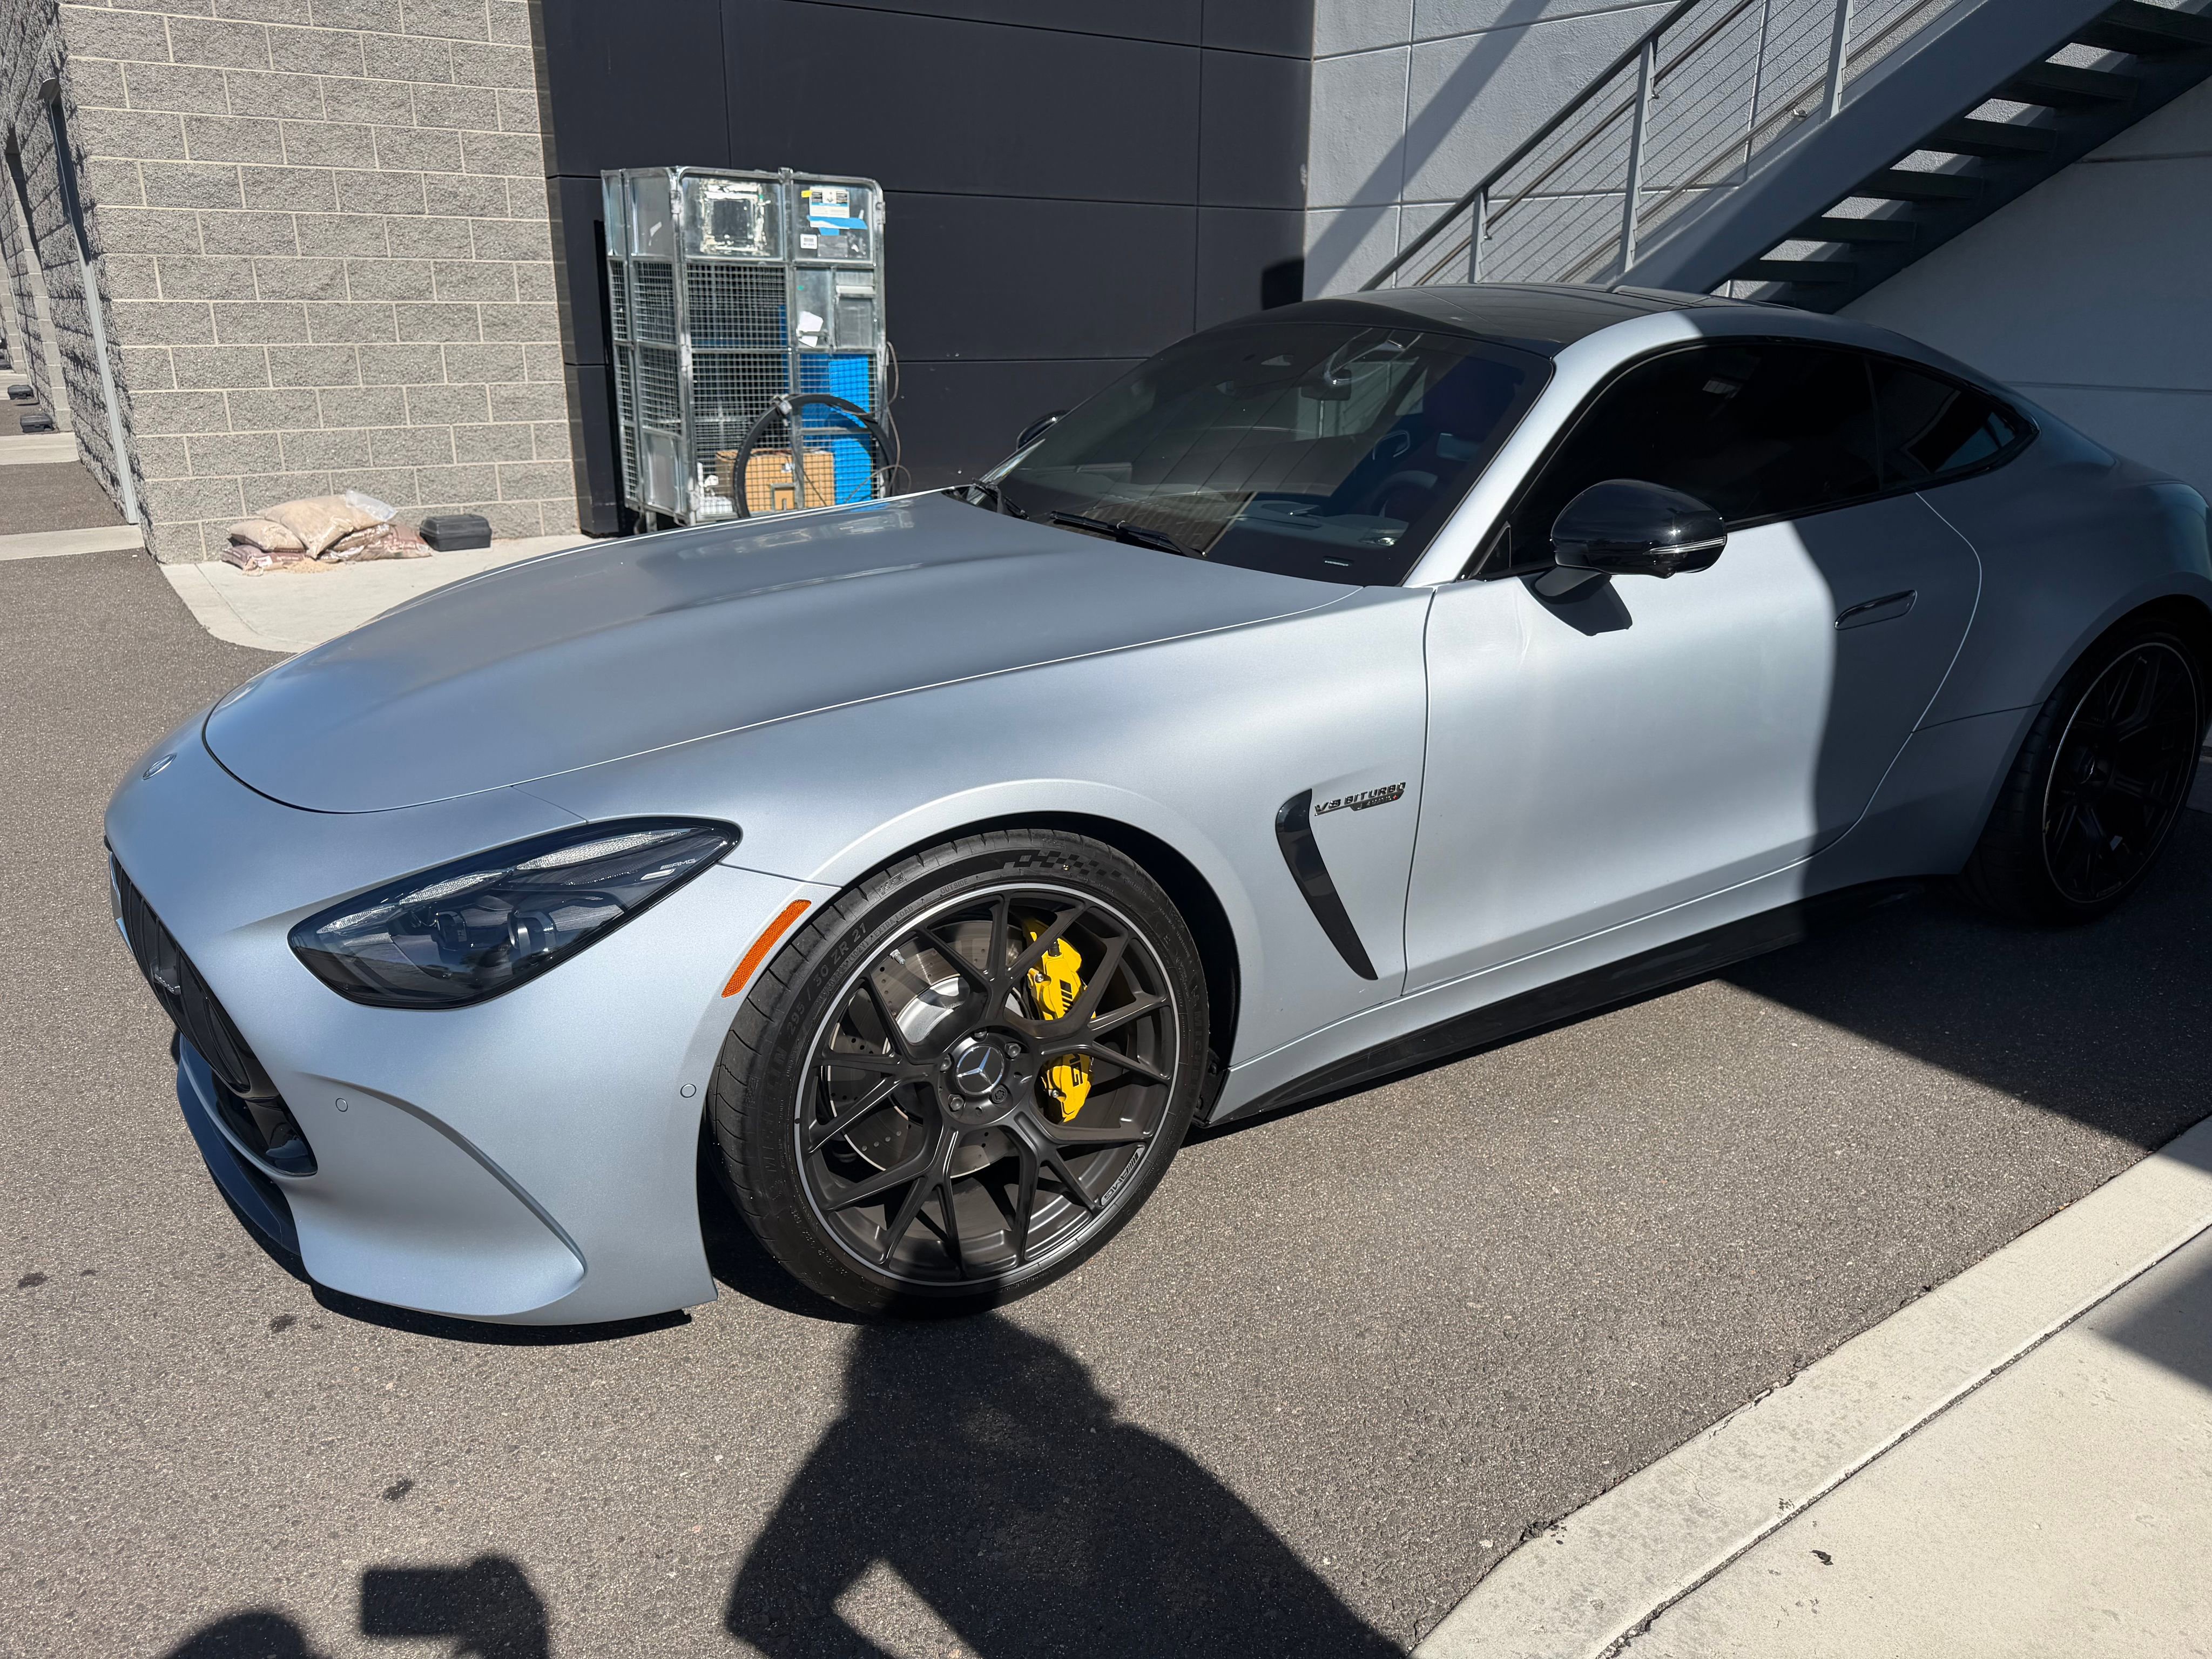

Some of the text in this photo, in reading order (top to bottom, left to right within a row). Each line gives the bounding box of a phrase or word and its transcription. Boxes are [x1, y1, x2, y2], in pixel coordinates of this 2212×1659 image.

[1314, 799, 1341, 812] V8
[1344, 782, 1406, 805] BITURBO
[940, 878, 968, 894] OUTSIDE
[873, 905, 914, 937] EXTRA LOAD
[787, 1003, 805, 1035] 295
[831, 940, 849, 965] ZR
[851, 922, 867, 942] 21
[1104, 1166, 1130, 1201] AMG
